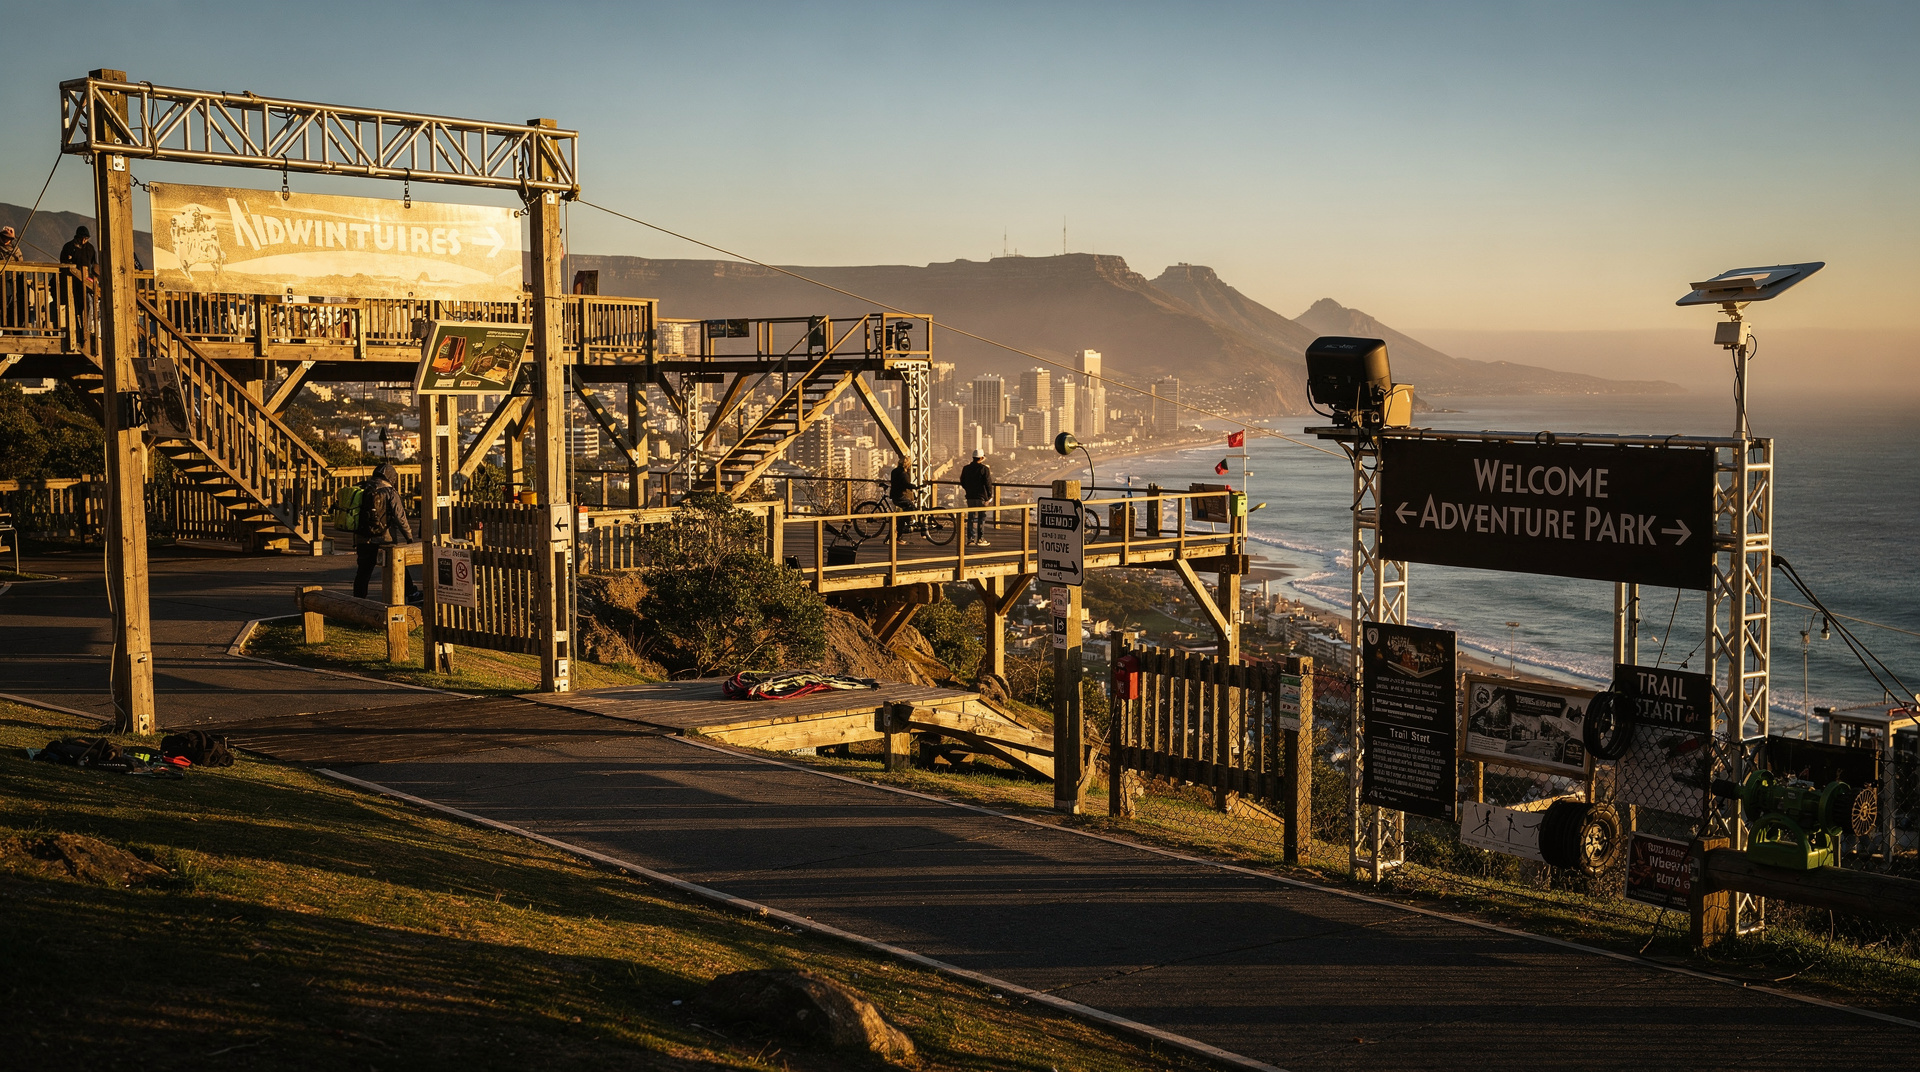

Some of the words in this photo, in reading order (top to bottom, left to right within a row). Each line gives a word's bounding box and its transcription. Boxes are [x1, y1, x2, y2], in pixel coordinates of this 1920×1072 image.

[1473, 458, 1609, 499] WELCOME
[1419, 494, 1576, 540] ADVENTURE
[1585, 506, 1657, 546] PARK
[1636, 672, 1687, 700] TRAIL
[1633, 697, 1684, 723] START
[1389, 727, 1408, 740] Trail
